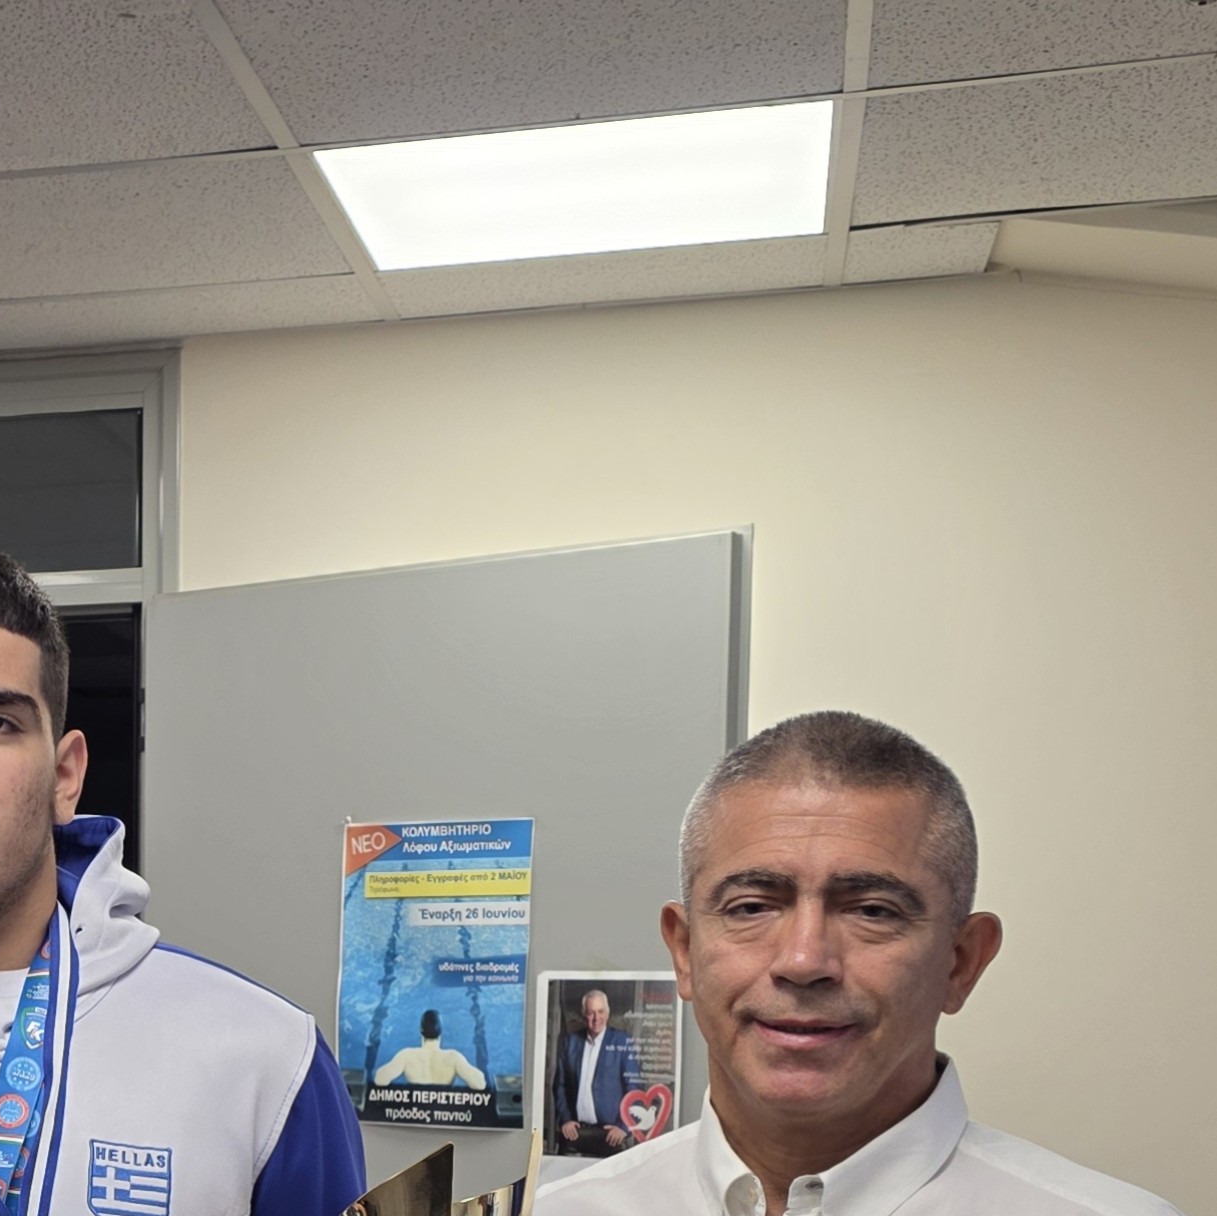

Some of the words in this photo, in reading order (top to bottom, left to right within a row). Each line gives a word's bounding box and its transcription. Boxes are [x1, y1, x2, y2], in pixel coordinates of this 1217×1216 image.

[402, 824, 492, 837] ΚΟΛΥΜΒΗΤΗΡΙΟ
[351, 832, 386, 855] ΝΕΟ
[402, 842, 438, 853] Λόφου
[439, 839, 512, 854] Αξιωματικών
[490, 872, 497, 881] 2
[419, 908, 462, 921] Έναρξη
[465, 908, 479, 919] 26
[482, 907, 525, 919] Ιουνίου
[369, 1089, 410, 1103] ΔΗΜΟΣ
[412, 1090, 491, 1106] ΠΕΡΙΣΤΕΡΙΟΥ
[385, 1107, 431, 1123] πρόοδος
[433, 1110, 472, 1122] παντού
[95, 1146, 166, 1168] HELLAS
